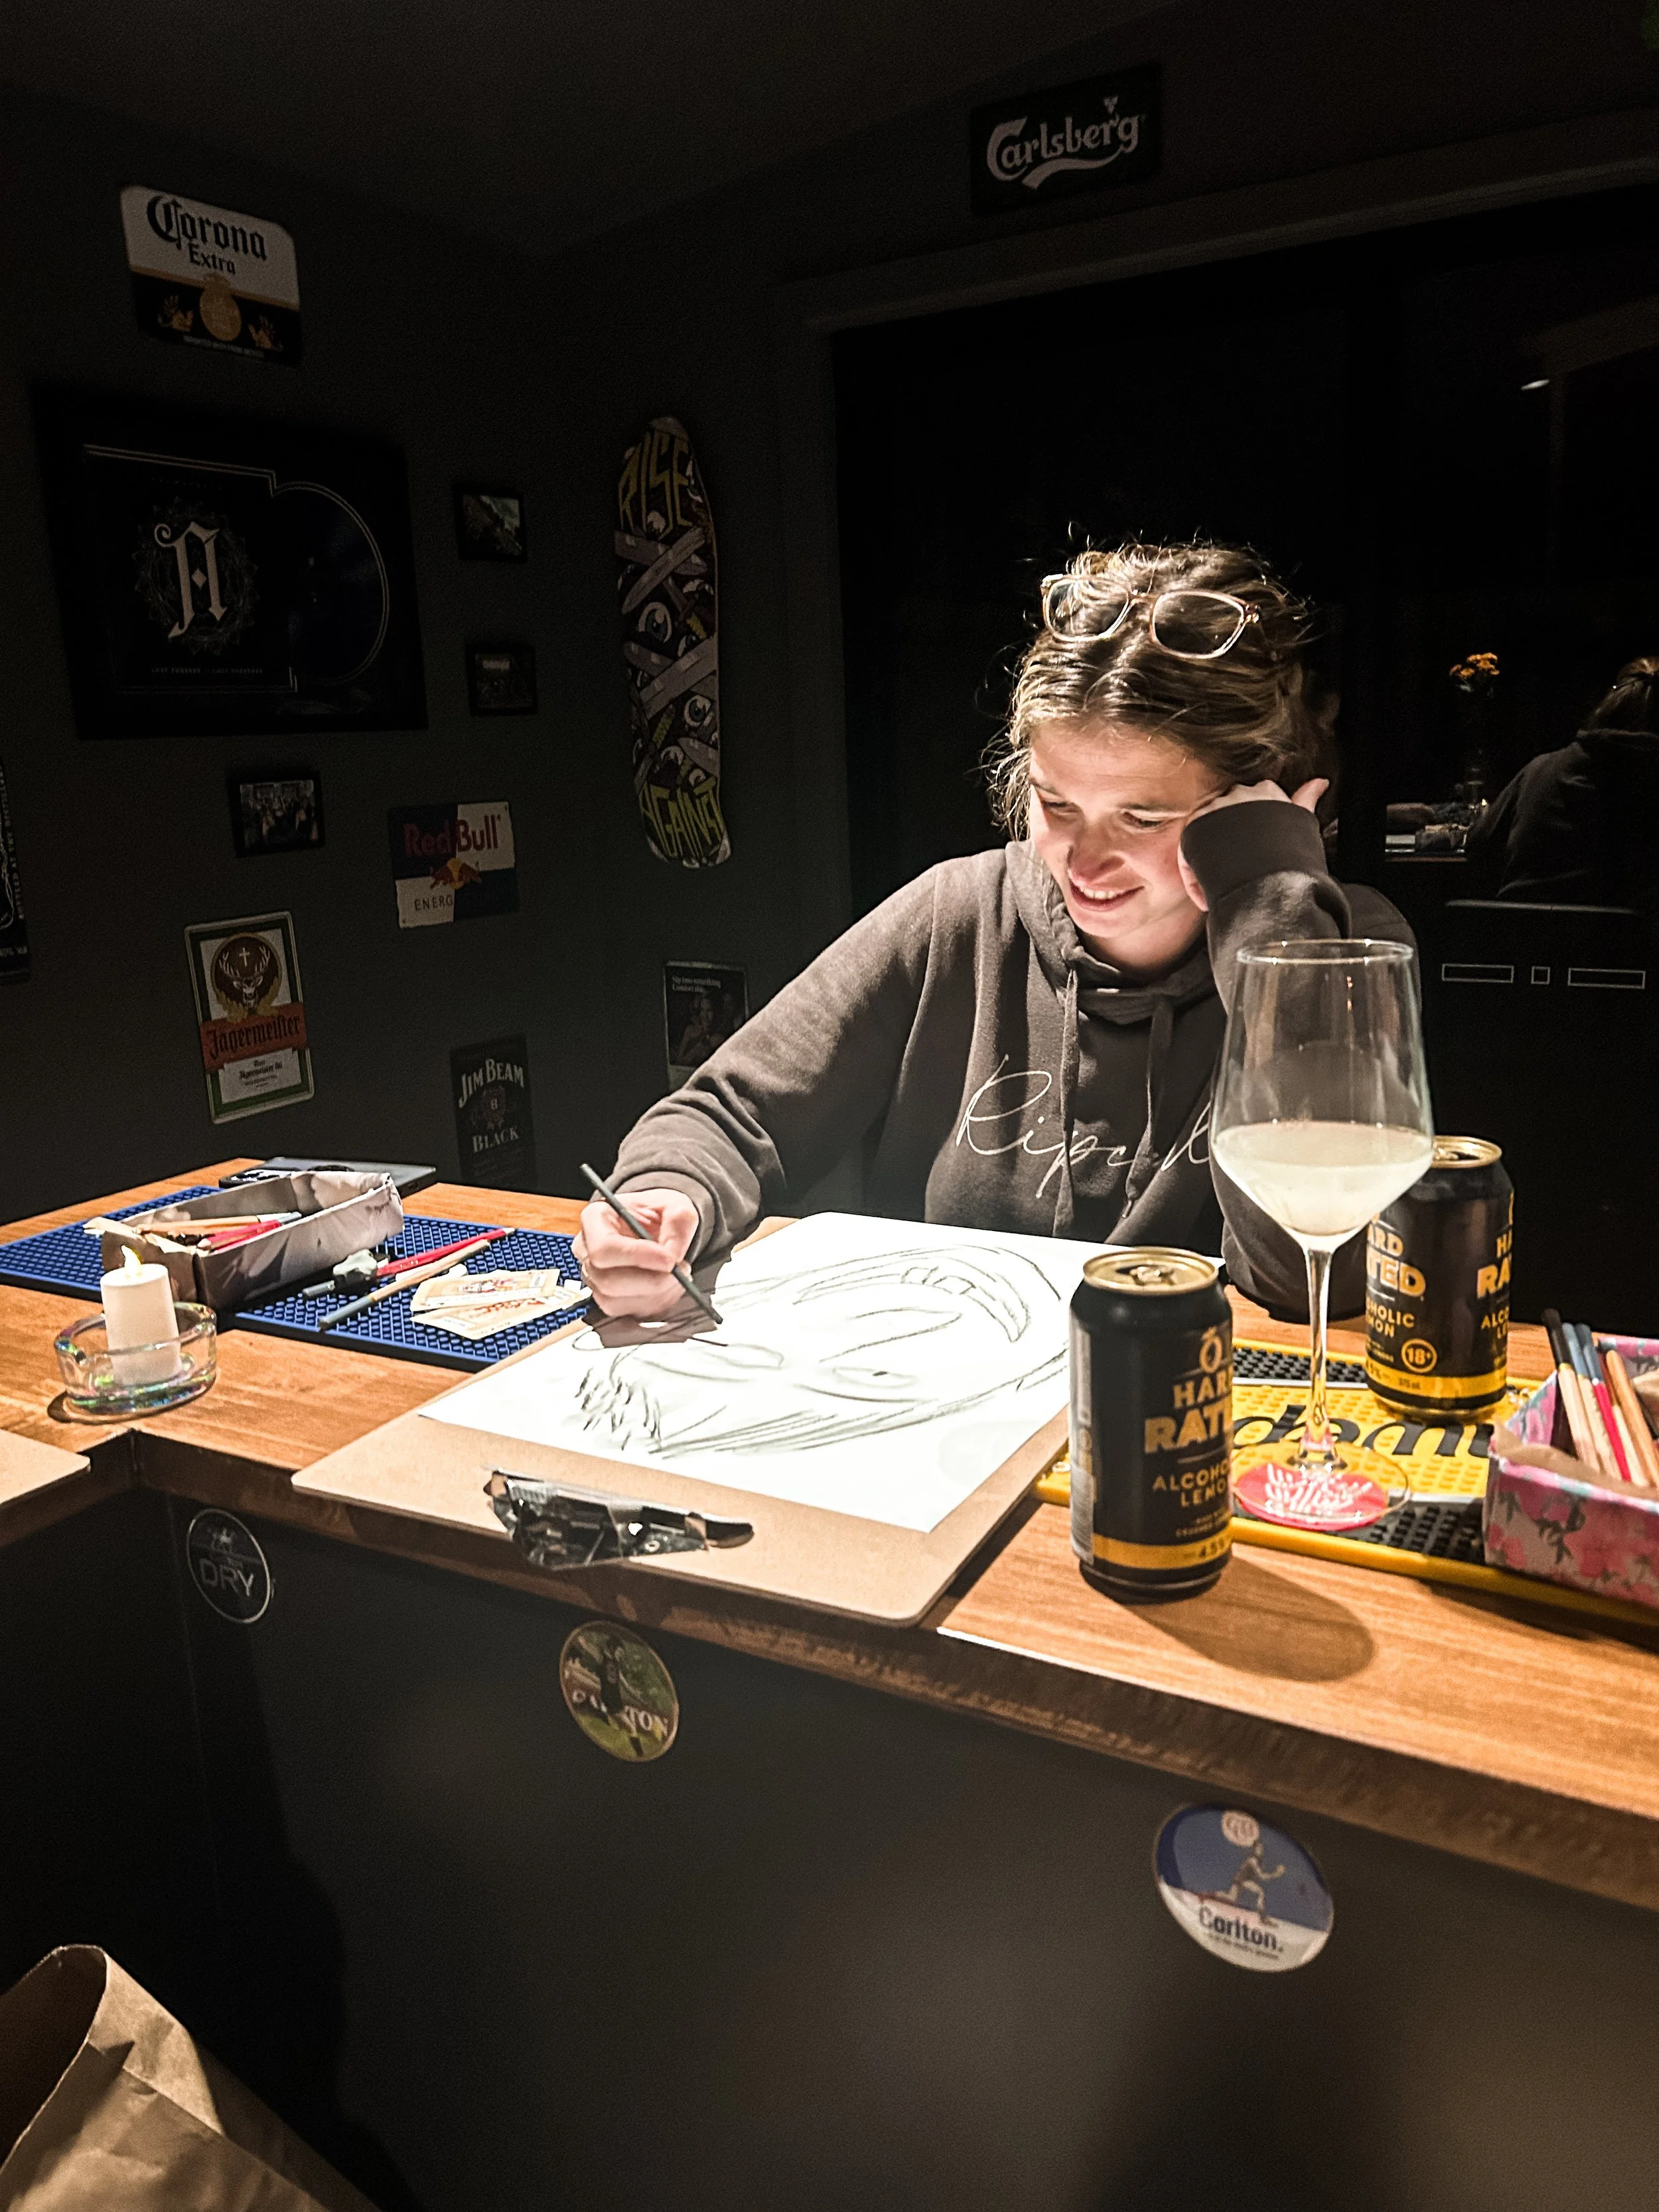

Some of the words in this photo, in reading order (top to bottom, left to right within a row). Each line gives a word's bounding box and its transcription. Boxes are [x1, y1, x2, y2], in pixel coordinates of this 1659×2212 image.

[987, 113, 1140, 188] Carlsberg
[147, 196, 266, 260] Corona
[188, 243, 236, 274] Extra
[618, 429, 693, 540] RISE
[403, 819, 453, 858] Red
[454, 814, 499, 852] Bull
[459, 1067, 484, 1109] JIM
[485, 1058, 525, 1088] BEAM
[472, 1126, 520, 1153] BLACK
[1366, 1243, 1427, 1297] TED
[1173, 1364, 1232, 1410] HAR
[1144, 1396, 1233, 1454] RAT
[1152, 1458, 1229, 1492] ALCOHO
[1181, 1477, 1228, 1508] LEMO
[199, 1558, 255, 1597] DRY
